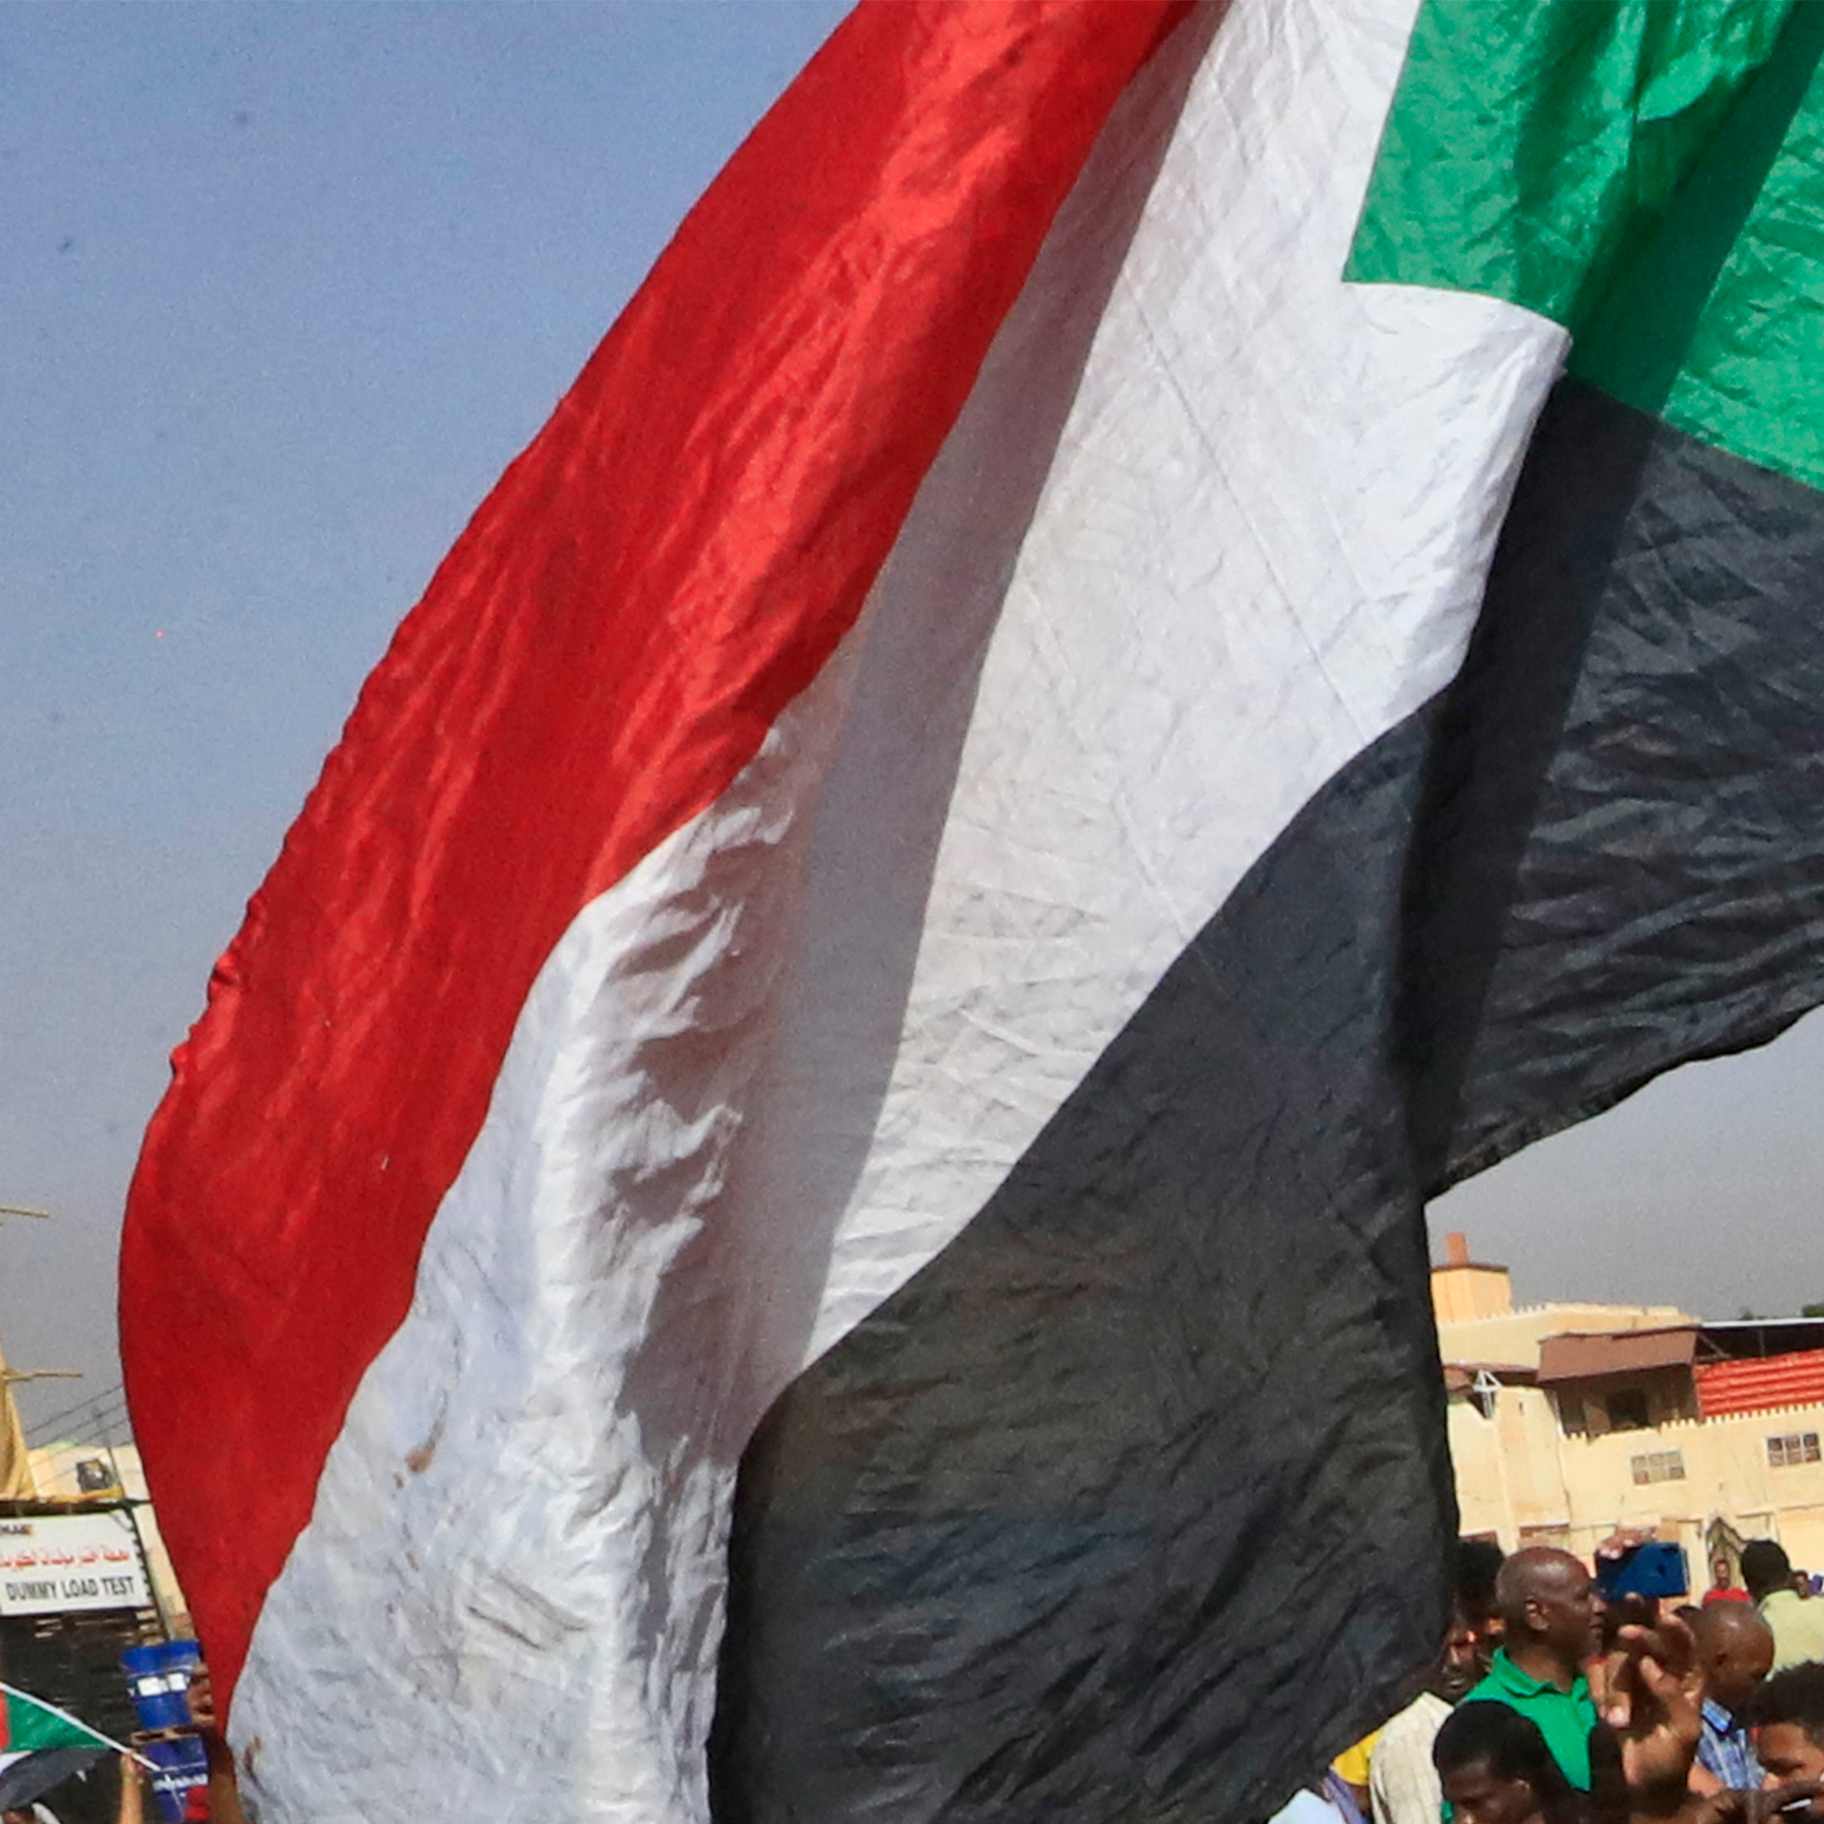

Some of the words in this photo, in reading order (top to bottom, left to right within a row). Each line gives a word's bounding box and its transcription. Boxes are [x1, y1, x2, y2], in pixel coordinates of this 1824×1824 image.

[5, 1581, 58, 1601] DUMMY
[61, 1578, 98, 1598] LOAD
[101, 1575, 135, 1596] TEST
